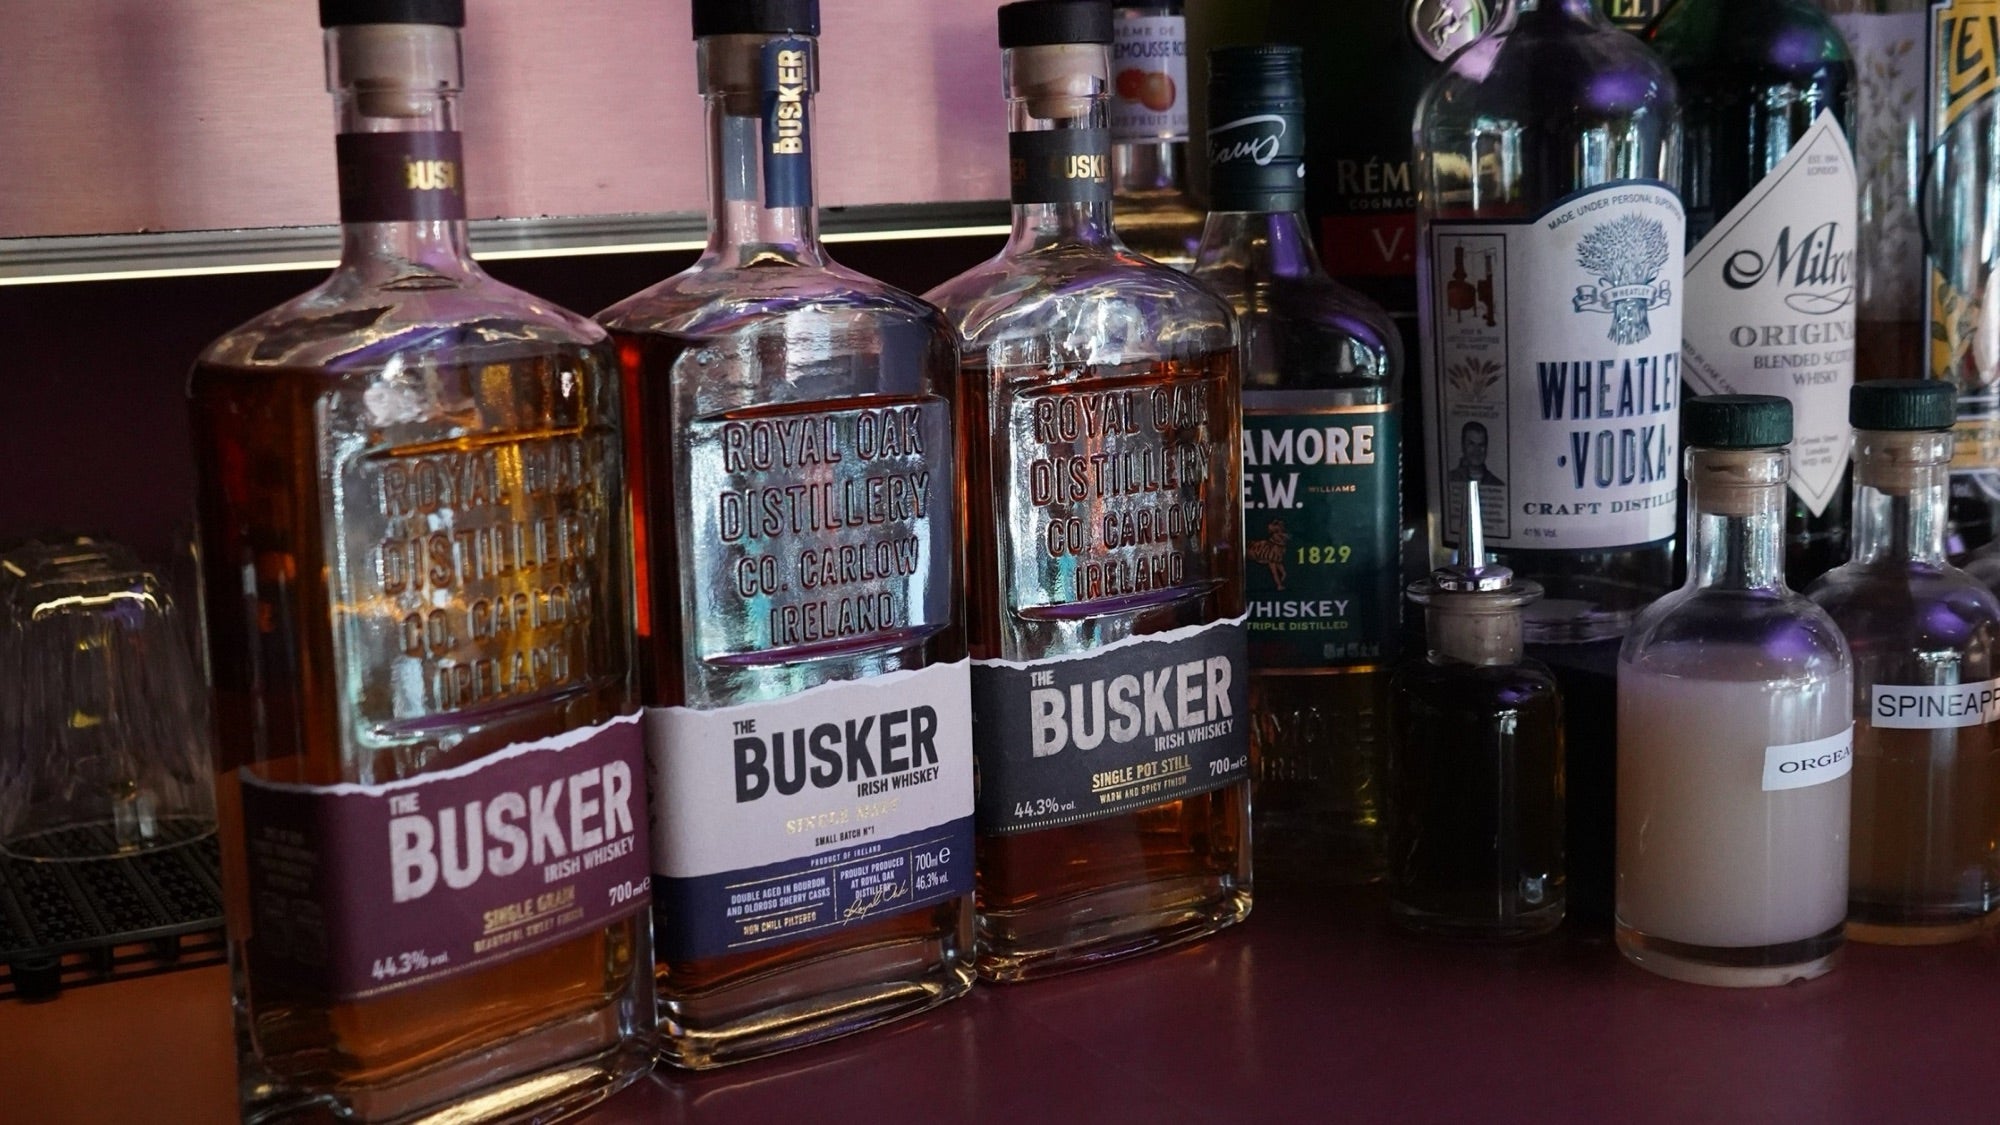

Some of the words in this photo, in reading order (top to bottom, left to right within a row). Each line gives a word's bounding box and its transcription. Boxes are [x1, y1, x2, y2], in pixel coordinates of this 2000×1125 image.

[777, 50, 803, 153] BUSKER
[1548, 211, 1576, 230] MADE
[1577, 199, 1610, 216] UNDER
[1612, 193, 1652, 204] PERSONAL
[1612, 290, 1650, 298] WHEATLEY
[1754, 353, 1820, 369] BLENDED
[1536, 353, 1681, 420] WHEATLEY
[1793, 371, 1838, 385] WHISKY
[1034, 391, 1141, 444] ROYAL
[723, 416, 842, 474] ROYAL
[857, 407, 924, 462] OAK
[1570, 424, 1666, 489] VODKA
[1031, 441, 1212, 506] DISTILLERY
[1308, 484, 1357, 493] WILLIAMS
[720, 471, 930, 542] DISTILLERY
[1523, 502, 1602, 515] CRAFT
[1047, 516, 1093, 558] CO.
[1103, 503, 1205, 550] CARLOW
[738, 554, 789, 599] CO.
[800, 535, 920, 591] CARLOW
[1297, 546, 1352, 565] 1829
[1075, 551, 1184, 602] IRELAND
[771, 591, 896, 646] IRELAND
[1246, 622, 1285, 630] TRIPLE
[1290, 621, 1348, 630] DISTILLED
[1031, 670, 1054, 688] THE
[1030, 655, 1233, 759] BUSKER
[733, 718, 756, 736] THE
[1154, 732, 1185, 753] IRISH
[1187, 719, 1234, 745] WHISKEY
[733, 704, 939, 804] BUSKER
[857, 777, 889, 798] IRISH
[891, 766, 940, 790] WHISKEY
[1092, 766, 1134, 789] SINGLE
[1136, 761, 1159, 779] POT
[1161, 754, 1191, 773] STILL
[390, 793, 420, 816] THE
[1100, 791, 1123, 805] WARM
[1124, 787, 1140, 800] AND
[1141, 782, 1162, 795] SPICY
[1163, 775, 1187, 789] FINISH
[784, 807, 849, 835] SINGLE
[1014, 797, 1059, 818] 44.3%
[1060, 800, 1076, 811] vol.
[389, 760, 634, 903] BUSKER
[815, 834, 837, 847] SMALL
[840, 828, 862, 841] BATCH
[544, 855, 580, 883] IRISH
[584, 835, 635, 870] WHISKEY
[810, 853, 841, 867] PRODUCT
[842, 851, 852, 860] OF
[853, 844, 882, 858] IRELAND
[840, 865, 869, 880] PROUDLY
[871, 856, 904, 874] PRODUCED
[731, 891, 760, 905] DOUBLE
[762, 886, 782, 898] AGED
[783, 883, 792, 894] IN
[793, 877, 826, 891] BOURBON
[851, 880, 860, 889] AT
[861, 875, 881, 887] ROYAL
[882, 870, 895, 881] OAK
[483, 899, 533, 930] SINGLE
[536, 884, 576, 912] GRAIN
[726, 906, 743, 917] AND
[744, 899, 778, 914] OLOROSO
[779, 893, 807, 907] SHERRY
[808, 887, 831, 900] CASKS
[761, 920, 782, 932] CHILL
[371, 950, 429, 980] 44.3%
